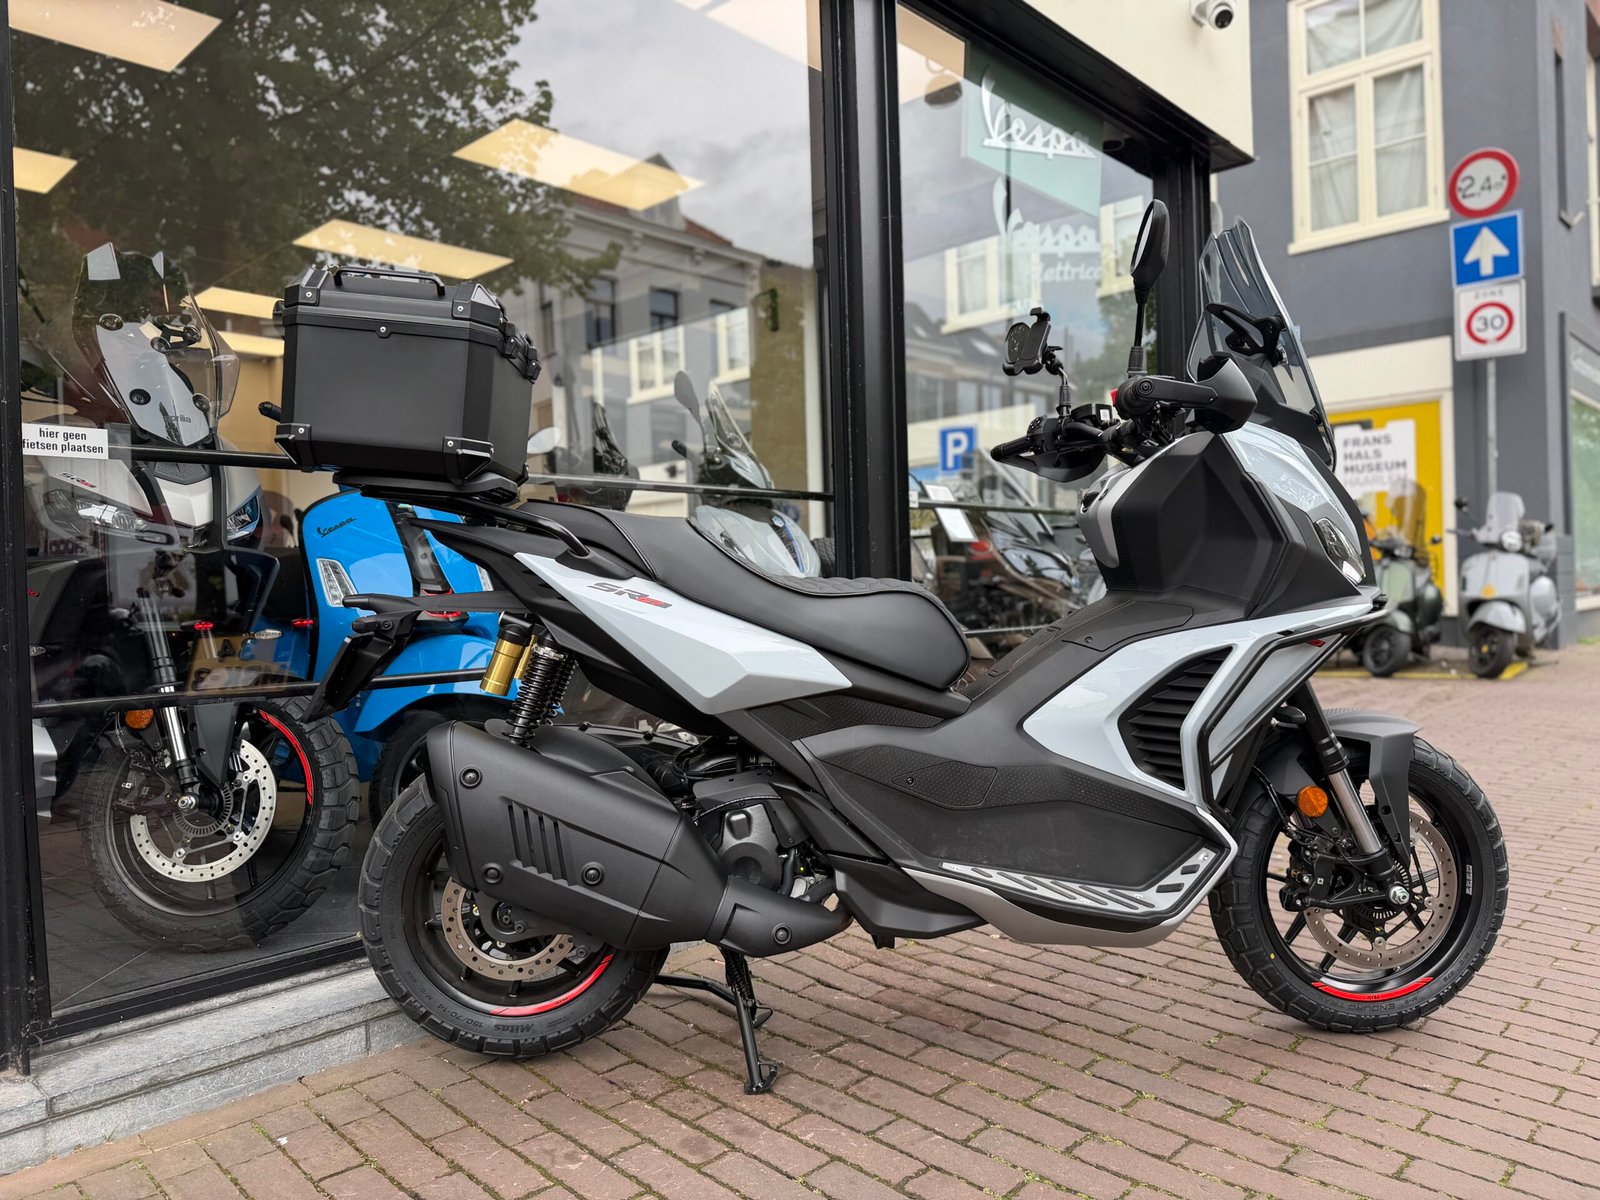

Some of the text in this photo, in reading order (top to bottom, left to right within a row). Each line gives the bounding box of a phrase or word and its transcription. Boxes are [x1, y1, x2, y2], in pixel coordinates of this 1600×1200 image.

[981, 66, 1096, 159] Vespa
[993, 176, 1101, 258] Vespa
[1474, 289, 1505, 300] ZONE
[1475, 314, 1505, 333] 30
[39, 427, 87, 441] hier geen
[1343, 434, 1392, 448] FRANS
[22, 439, 104, 453] fietsen plaatsen
[947, 432, 969, 468] P
[1343, 449, 1382, 461] HALS
[1344, 460, 1407, 473] MUSEUM
